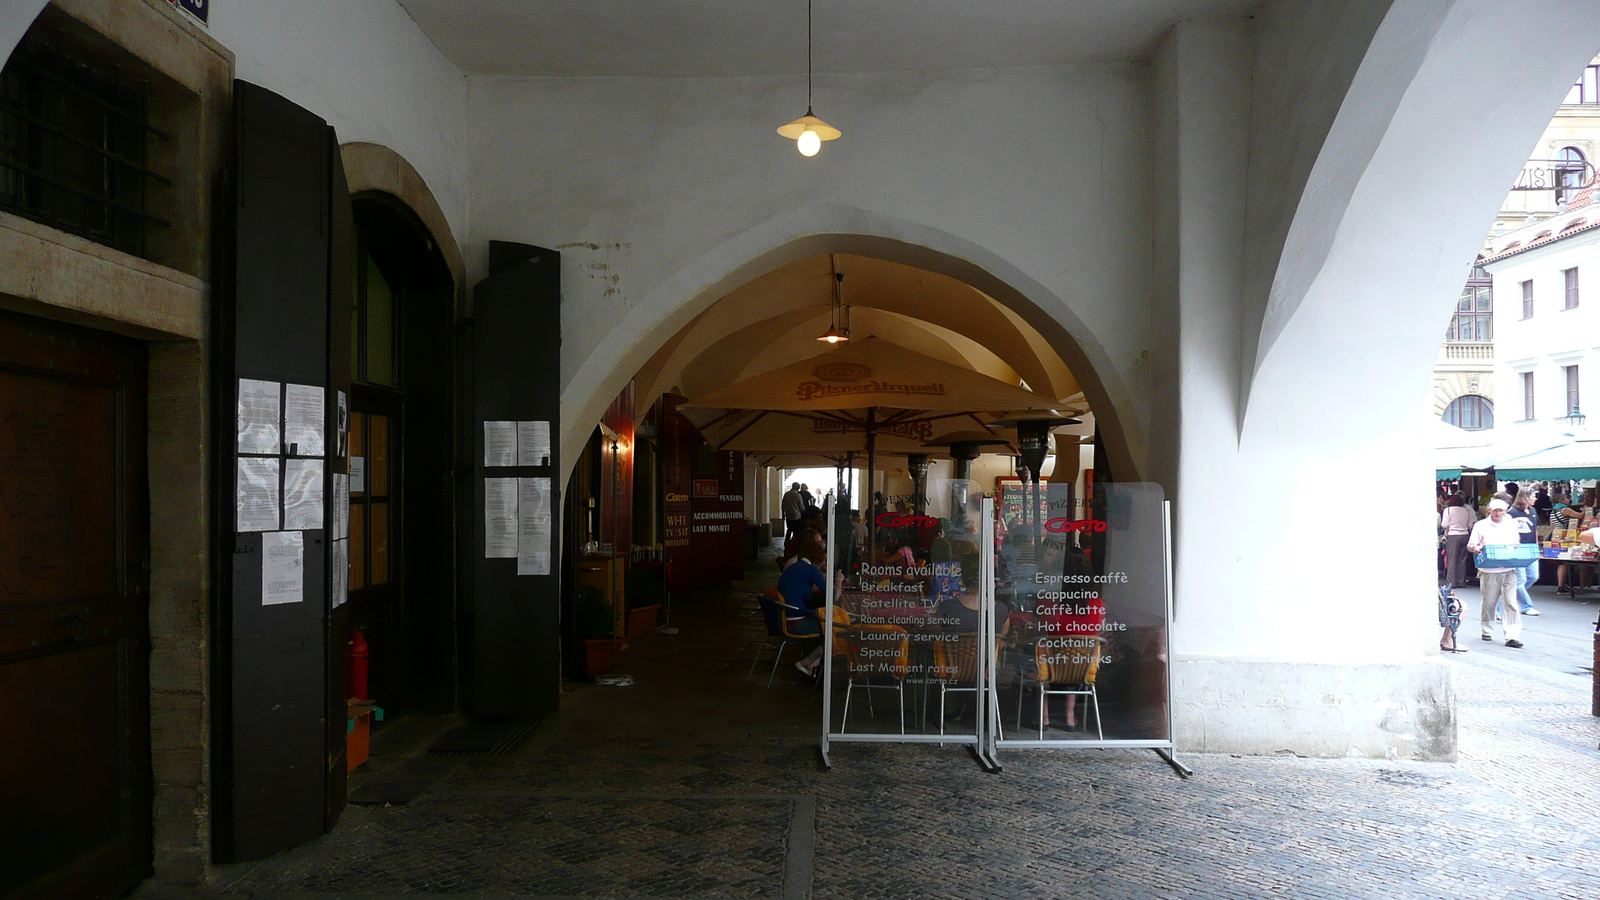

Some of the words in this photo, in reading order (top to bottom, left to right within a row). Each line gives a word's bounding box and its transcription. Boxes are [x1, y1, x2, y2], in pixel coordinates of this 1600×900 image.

[796, 381, 870, 401] Pilsner
[871, 380, 946, 396] Urquell
[667, 515, 687, 526] WI-FI
[692, 511, 744, 520] ACCOMMODATION
[876, 512, 938, 528] CORTO
[692, 525, 708, 533] LAST
[708, 524, 731, 533] MINUTE
[1045, 517, 1108, 533] CORTO
[861, 561, 902, 576] Rooms
[906, 562, 962, 577] available
[1035, 572, 1091, 586] Espresso
[1093, 571, 1129, 584] caffè
[861, 581, 925, 593] Breakfast
[1036, 588, 1099, 602] Cappucino
[861, 598, 916, 608] Satellite
[920, 598, 939, 609] TV
[1035, 603, 1073, 616] Caffè
[1075, 603, 1107, 615] latte
[860, 614, 885, 624] Room
[887, 614, 925, 628] cleaning
[926, 616, 961, 625] service
[1037, 620, 1062, 632] Hot
[1065, 617, 1127, 632] chocolate
[860, 630, 911, 644] Laundry
[913, 632, 960, 642] service
[1037, 636, 1096, 648] Cocktails
[860, 647, 905, 659] Special
[1038, 653, 1070, 665] Soft
[849, 661, 875, 672] Last
[878, 662, 924, 673] Moment
[927, 664, 959, 674] rates
[905, 677, 958, 685] www.corto.cz
